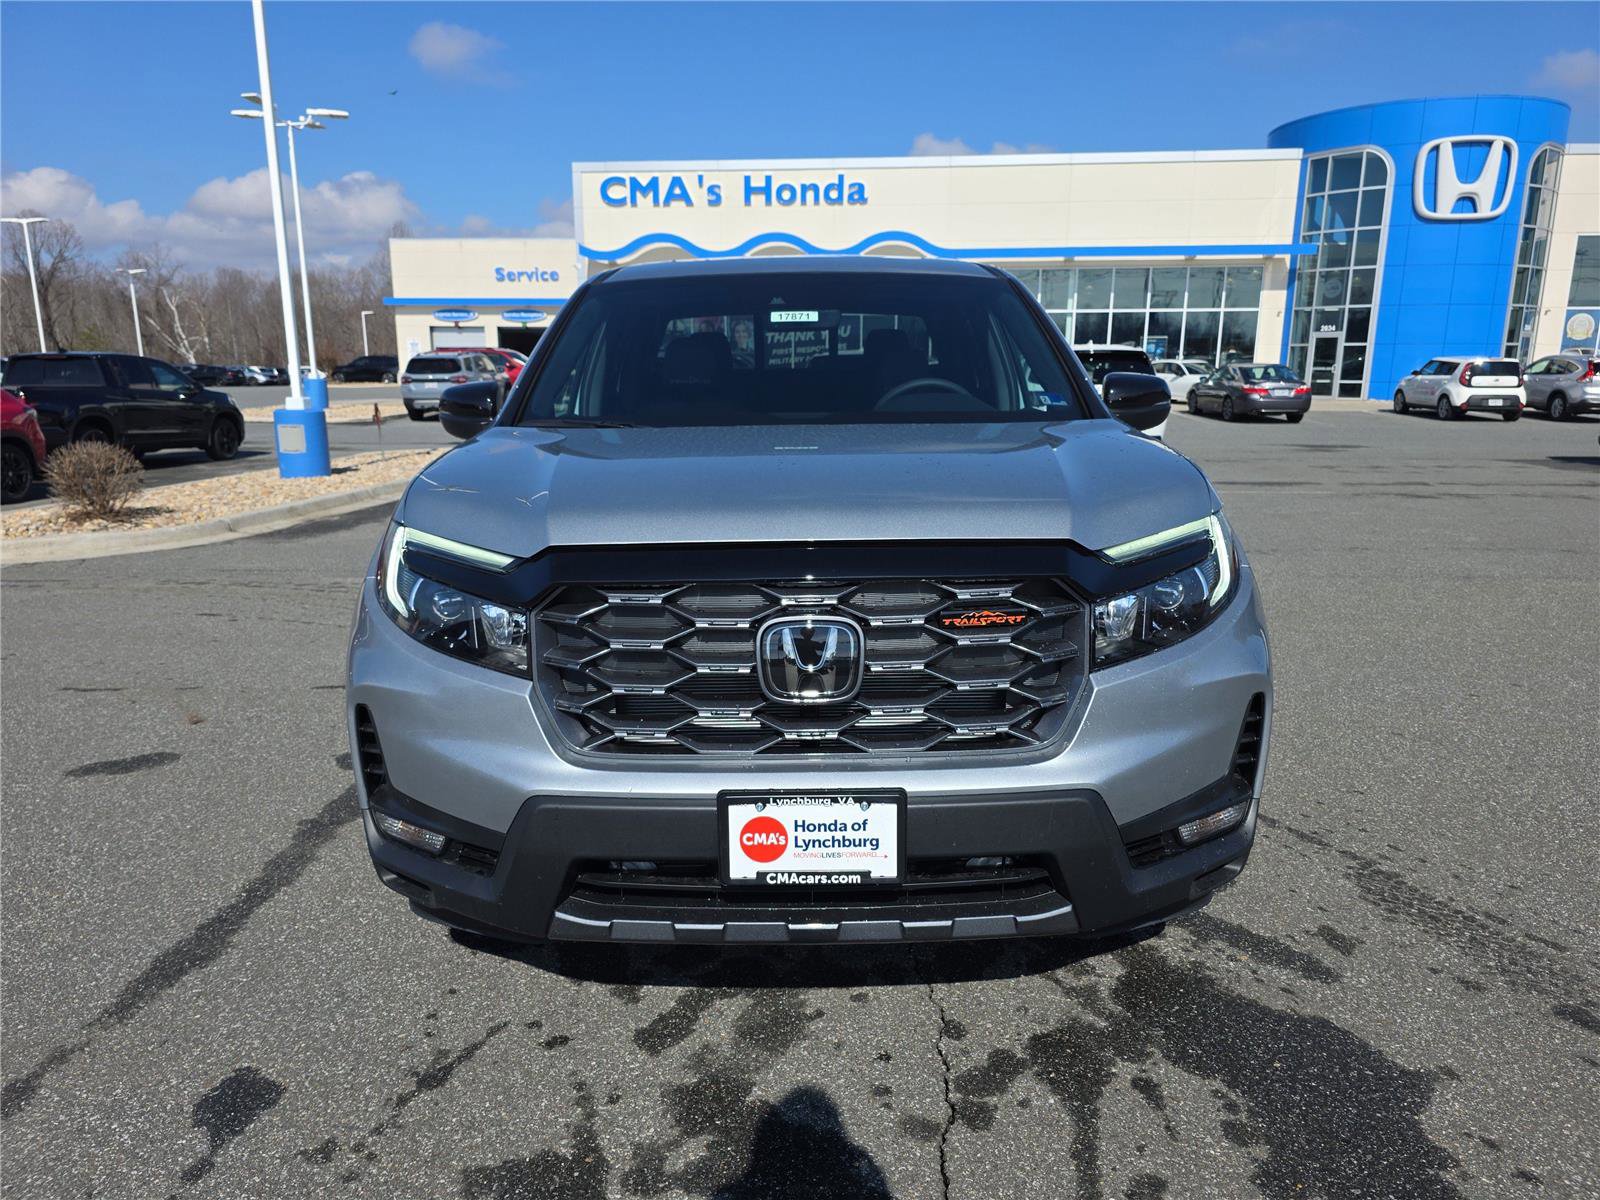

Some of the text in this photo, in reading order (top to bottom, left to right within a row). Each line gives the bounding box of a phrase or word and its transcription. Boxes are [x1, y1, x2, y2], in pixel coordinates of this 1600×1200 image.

[600, 174, 868, 208] CMA's Honda
[495, 266, 560, 282] Service
[778, 312, 810, 321] 17871
[765, 331, 815, 344] THANK
[942, 615, 1026, 626] TRAILSPORT
[769, 797, 855, 807] Lynchburg, VA
[794, 818, 869, 833] Honda of
[742, 832, 786, 846] CMA's
[794, 835, 880, 851] Lynchburg
[766, 872, 861, 885] CMAcars.com
